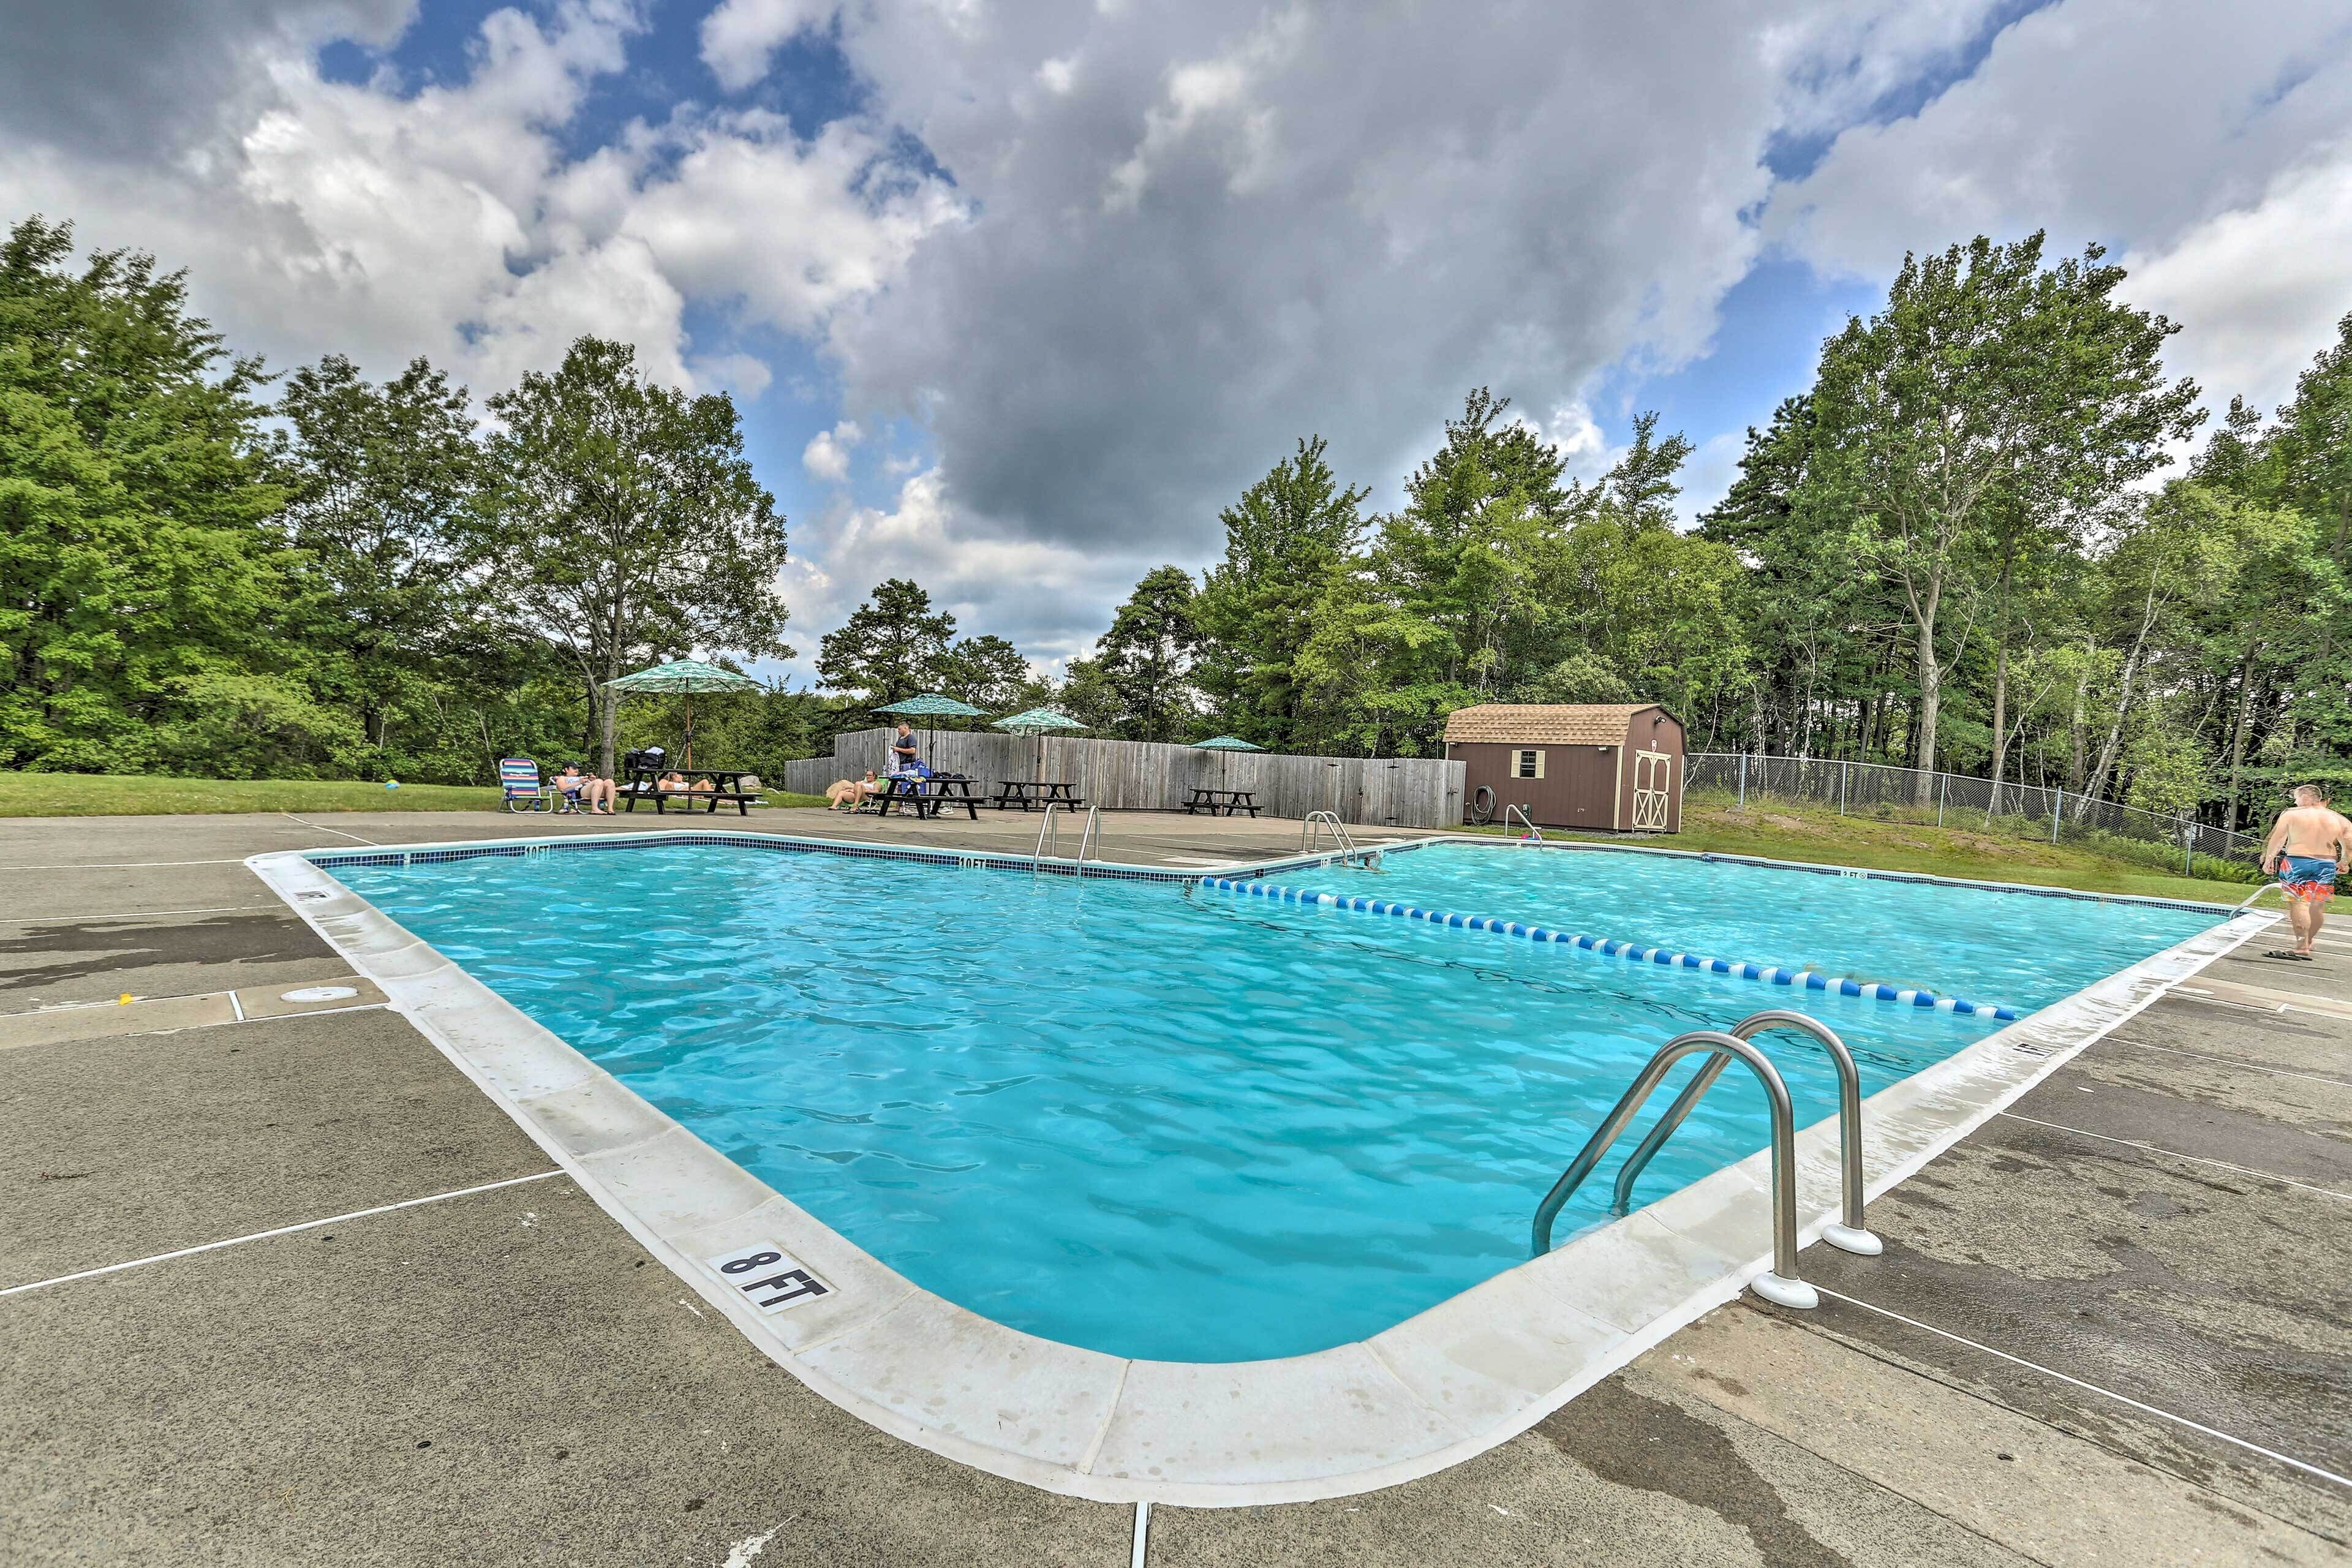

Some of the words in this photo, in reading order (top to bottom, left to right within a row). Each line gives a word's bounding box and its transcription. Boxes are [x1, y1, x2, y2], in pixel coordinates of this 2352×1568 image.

[960, 858, 972, 869] 10
[973, 858, 985, 869] FT
[720, 1251, 782, 1274] 8
[741, 1268, 829, 1308] FT
